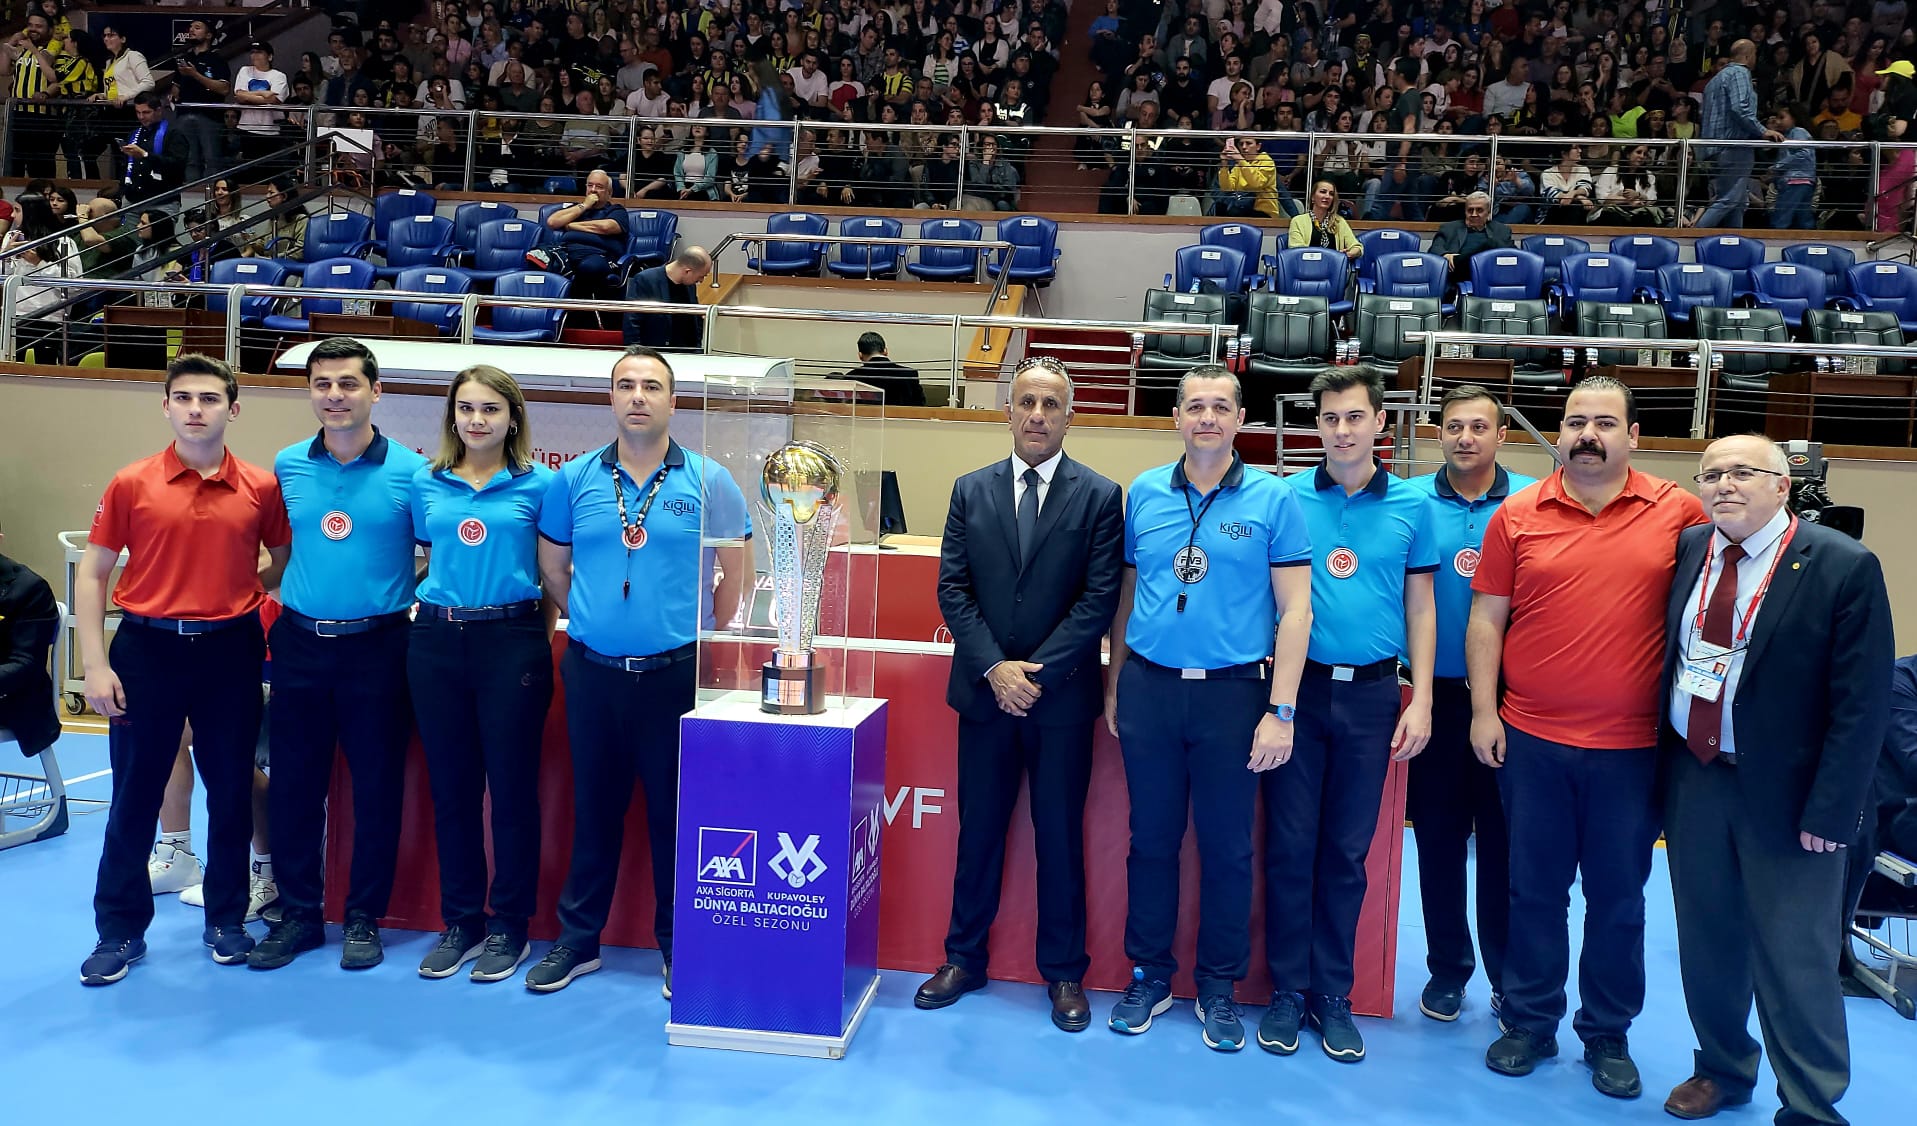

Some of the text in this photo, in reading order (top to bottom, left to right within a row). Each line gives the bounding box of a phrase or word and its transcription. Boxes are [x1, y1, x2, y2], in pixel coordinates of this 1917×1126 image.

[531, 448, 586, 470] ÜRK
[1180, 556, 1202, 565] FVB
[884, 786, 945, 829] VF
[700, 856, 746, 880] AXA
[696, 886, 714, 896] AXA
[767, 891, 826, 904] KUPAVOLEY
[694, 896, 829, 919] DÜNYA BALTACIOĞLU
[712, 912, 811, 931] ÖZEL SEZONU
